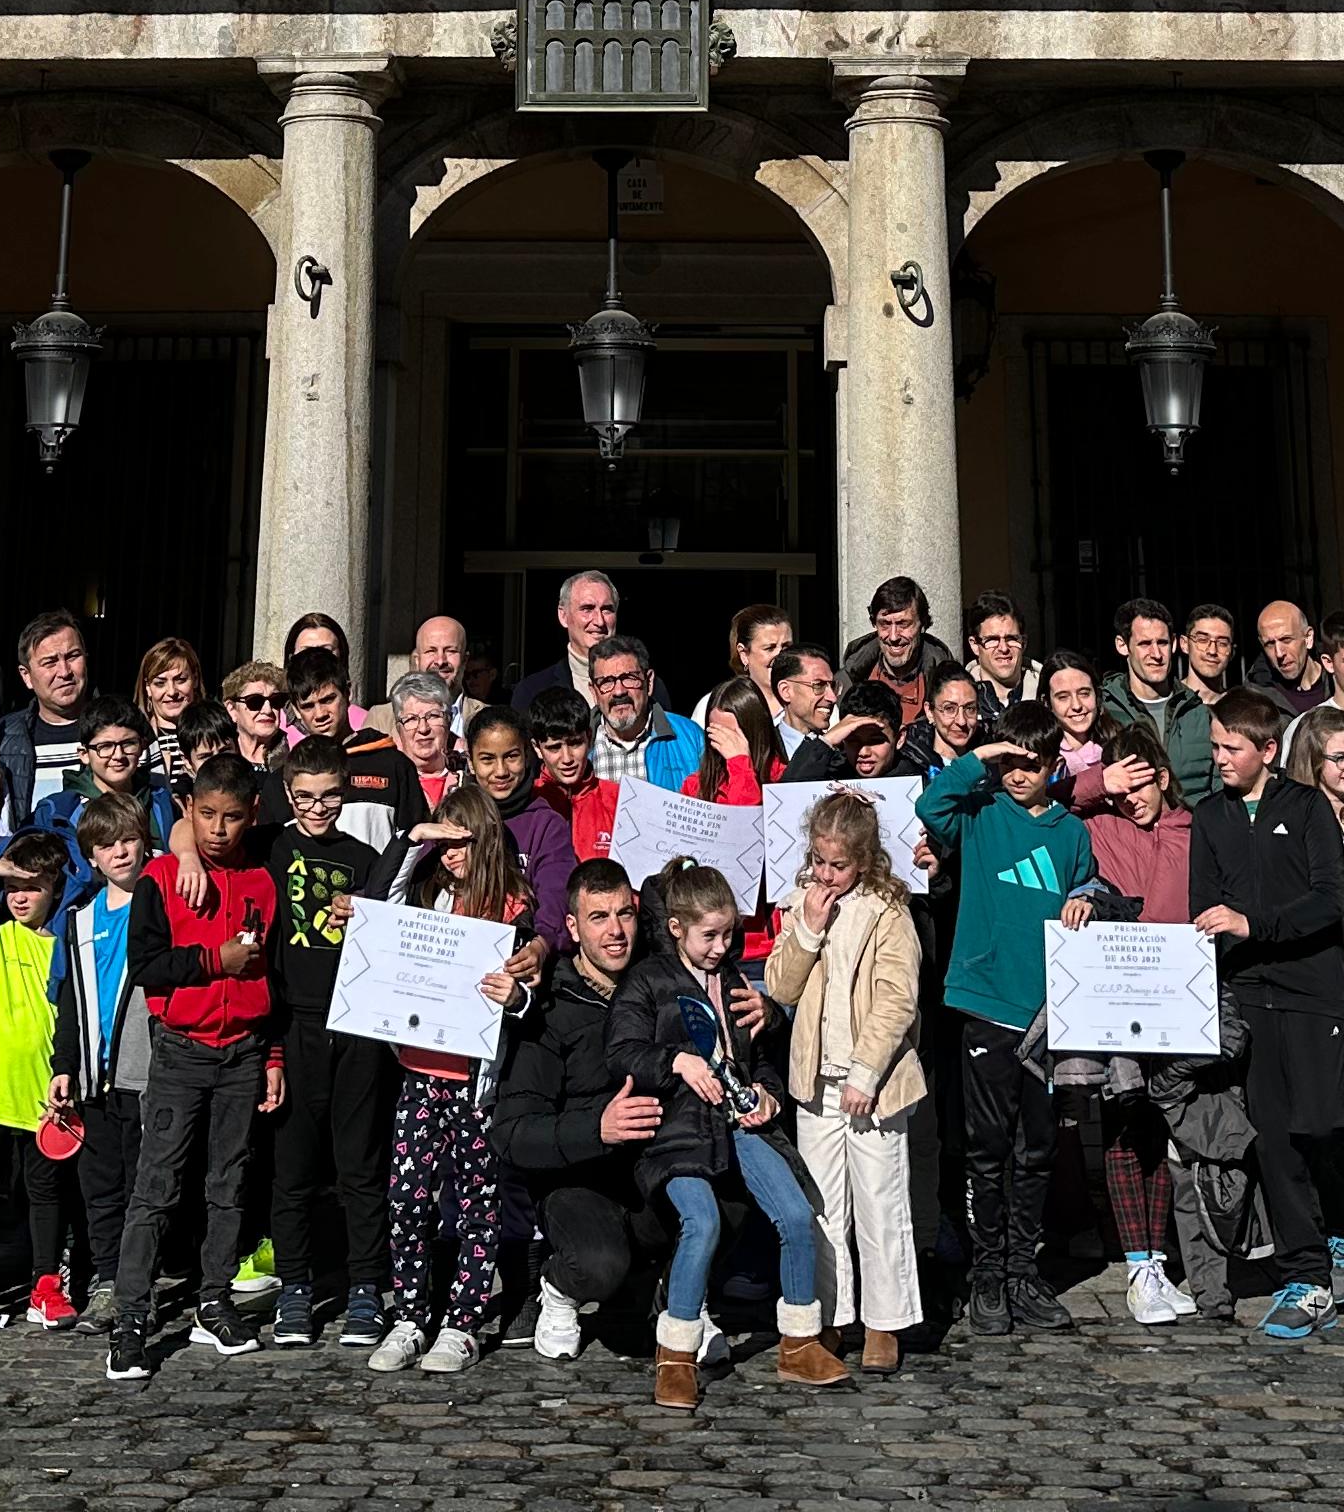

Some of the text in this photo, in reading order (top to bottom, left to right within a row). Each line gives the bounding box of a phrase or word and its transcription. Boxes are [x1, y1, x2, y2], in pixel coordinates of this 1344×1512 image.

[666, 820, 677, 829] DE
[679, 822, 697, 833] AÑO
[400, 941, 412, 950] DE
[414, 942, 433, 954] AÑO
[1120, 953, 1139, 963] AÑO
